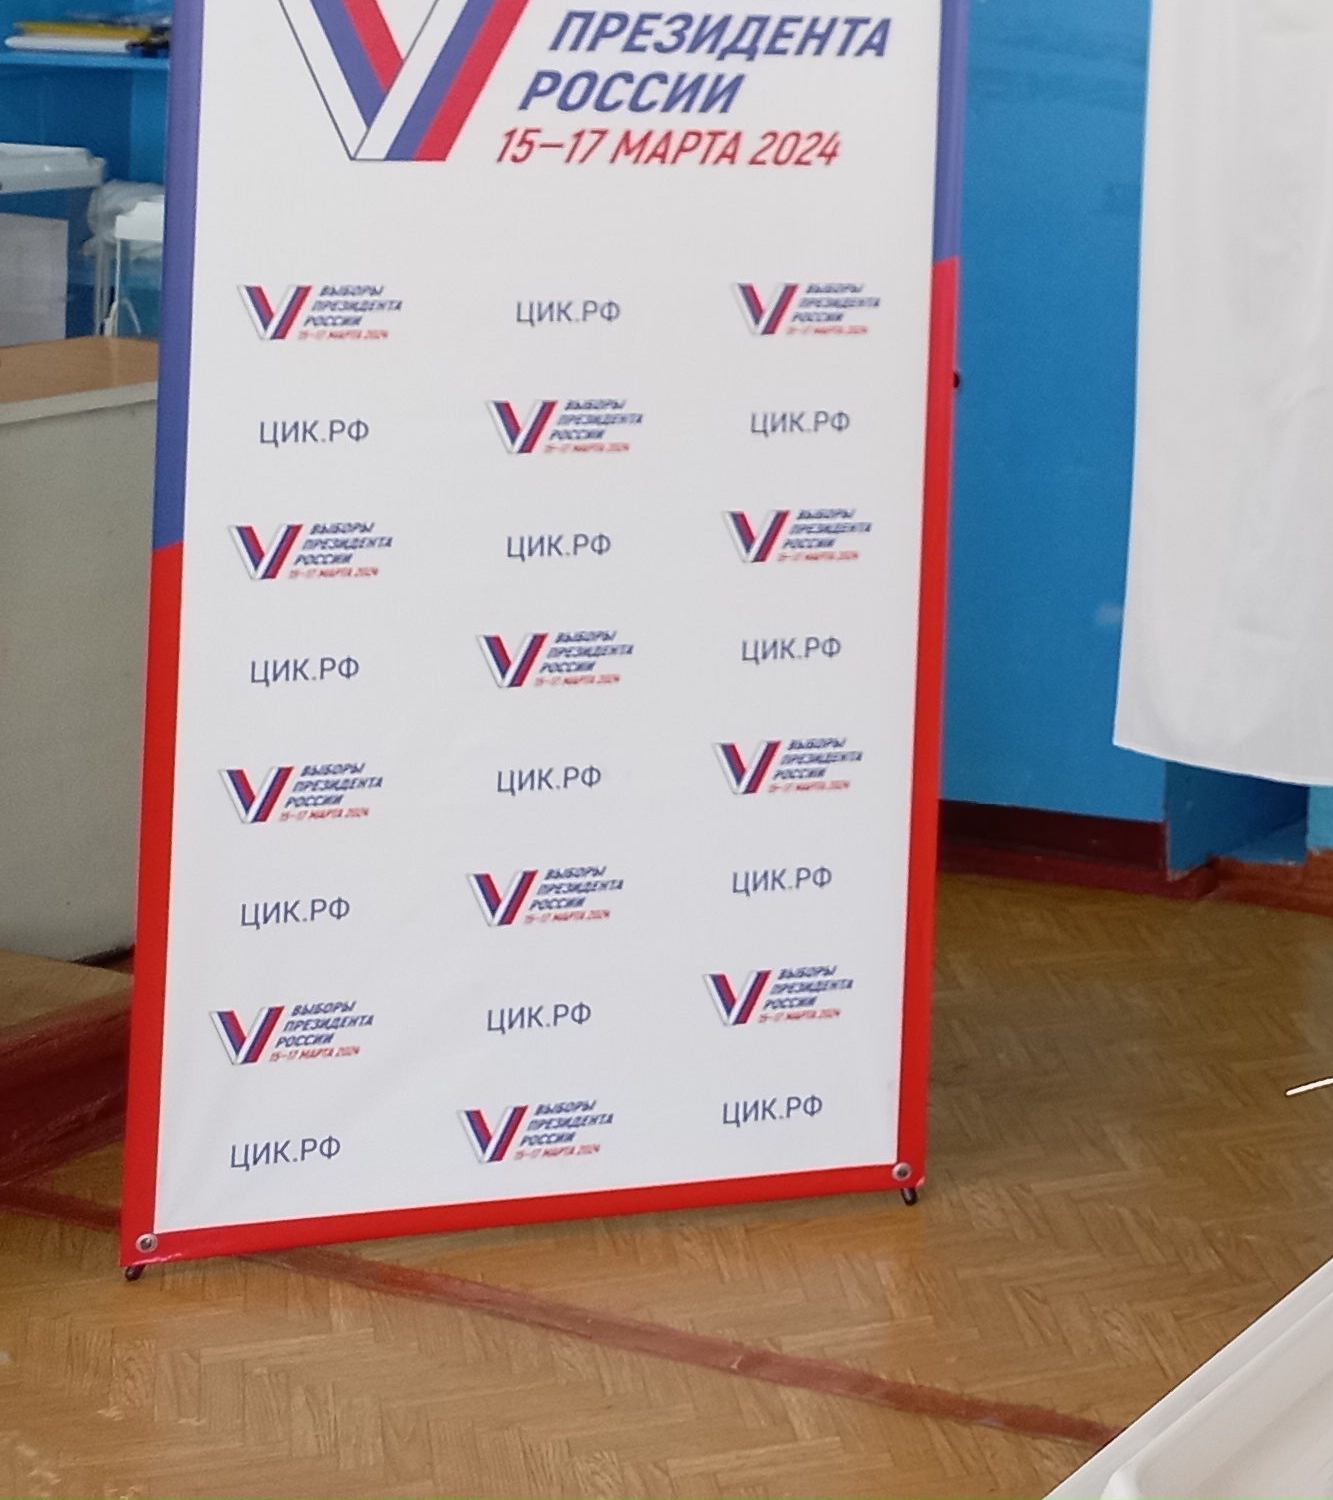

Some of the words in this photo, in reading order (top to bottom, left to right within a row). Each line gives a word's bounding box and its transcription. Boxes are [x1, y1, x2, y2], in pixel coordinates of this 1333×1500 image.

[549, 10, 891, 60] ПРЕЗИДЕНТА
[518, 70, 746, 114] РОССИИ
[613, 129, 742, 165] МАРТА
[748, 130, 840, 166] 2024
[516, 300, 621, 327] ЦИК.РФ
[260, 419, 369, 448] ЦИК.РФ
[751, 411, 850, 438] ЦИК.РФ
[507, 533, 611, 562] ЦИК.РФ
[742, 636, 842, 666] ЦИК.РФ
[251, 656, 359, 688] ЦИК.РФ
[497, 765, 602, 797] ЦИК.РФ
[732, 866, 832, 897] ЦИК.РФ
[241, 897, 350, 930] ЦИК.РФ
[283, 1015, 374, 1031] ПРЕЗИДЕНТА
[291, 1001, 356, 1016] ВЫБОРЫ
[487, 1002, 591, 1035] ЦИК.РФ
[275, 1033, 334, 1048] РОССИИ
[527, 1114, 613, 1130] ПРЕЗИДЕНТА
[535, 1101, 596, 1115] ВЫБОРЫ
[723, 1094, 823, 1128] ЦИК.РФ
[231, 1135, 341, 1172] ЦИК.РФ
[520, 1132, 576, 1146] РОССИИ
